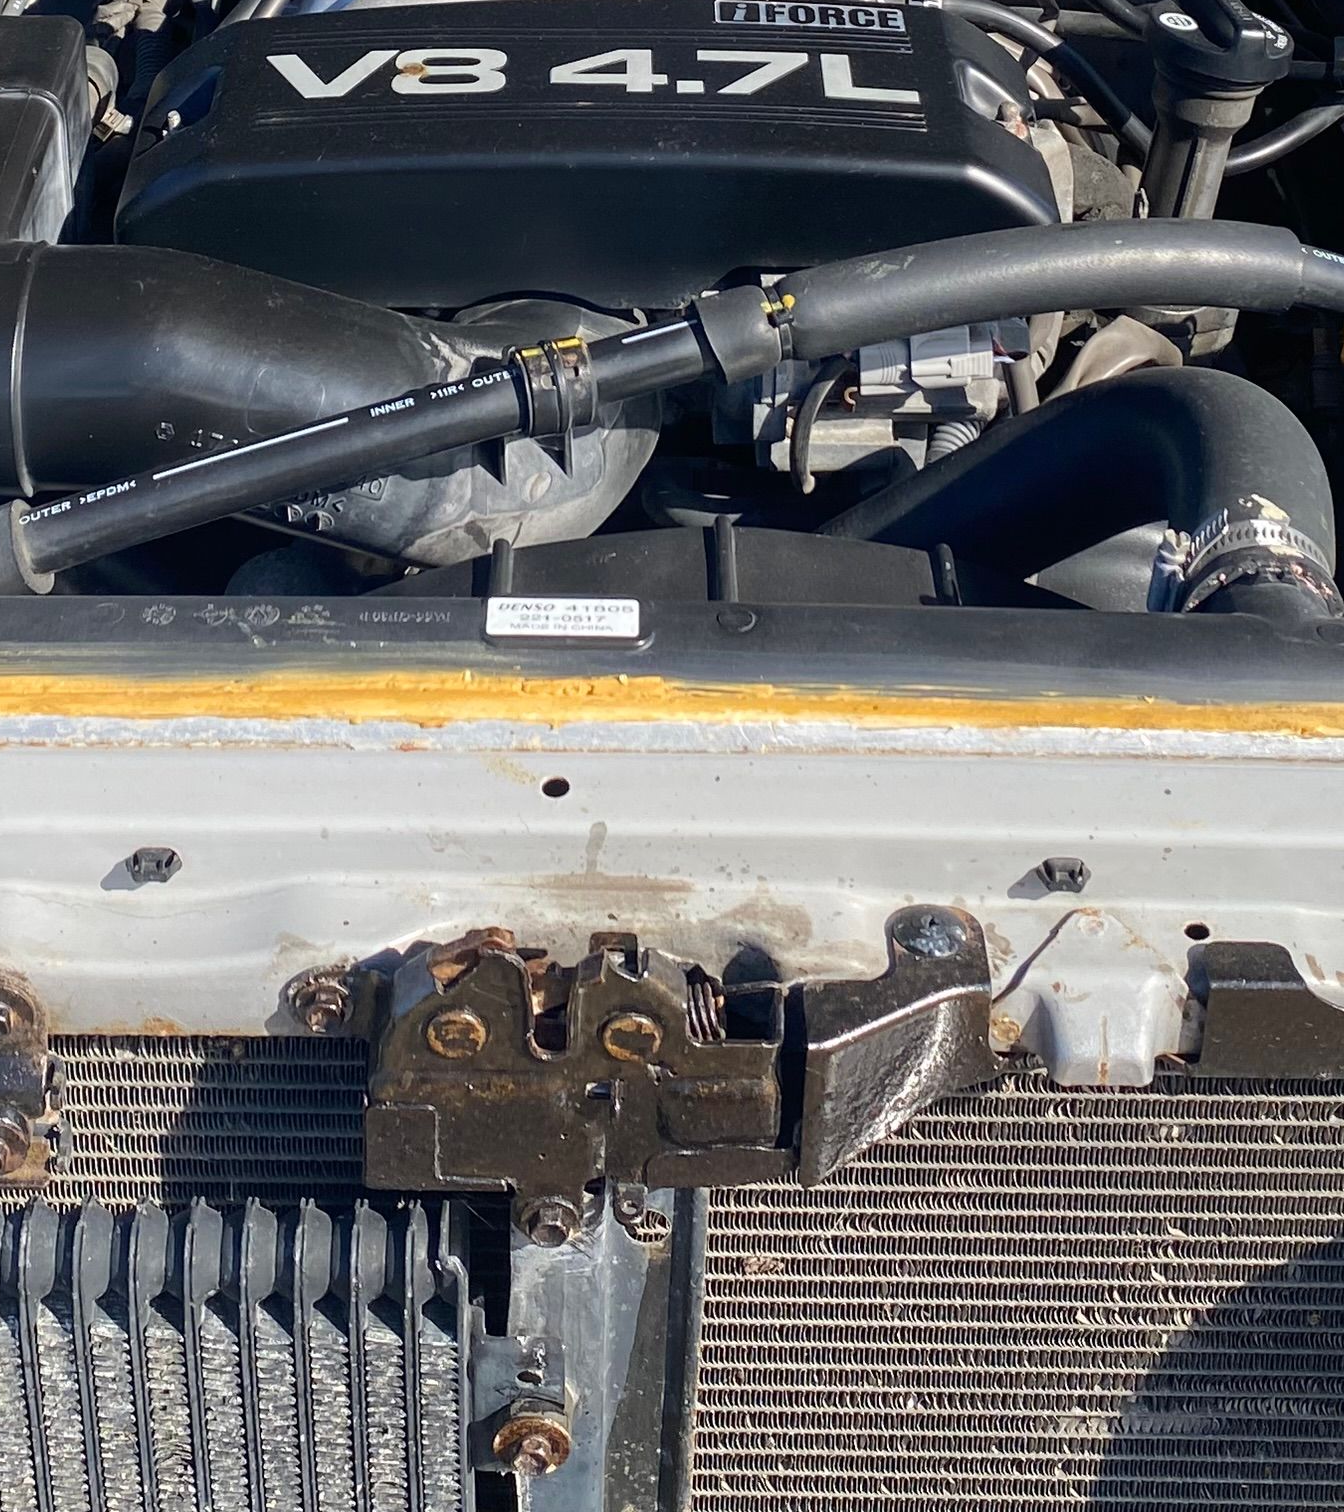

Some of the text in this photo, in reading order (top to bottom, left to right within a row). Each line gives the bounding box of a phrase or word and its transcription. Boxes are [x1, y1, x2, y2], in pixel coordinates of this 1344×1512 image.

[266, 48, 920, 103] V8 4.7L
[369, 397, 416, 418] INNER
[18, 479, 137, 525] OUTER >EPDM<
[497, 602, 555, 612] DENSO
